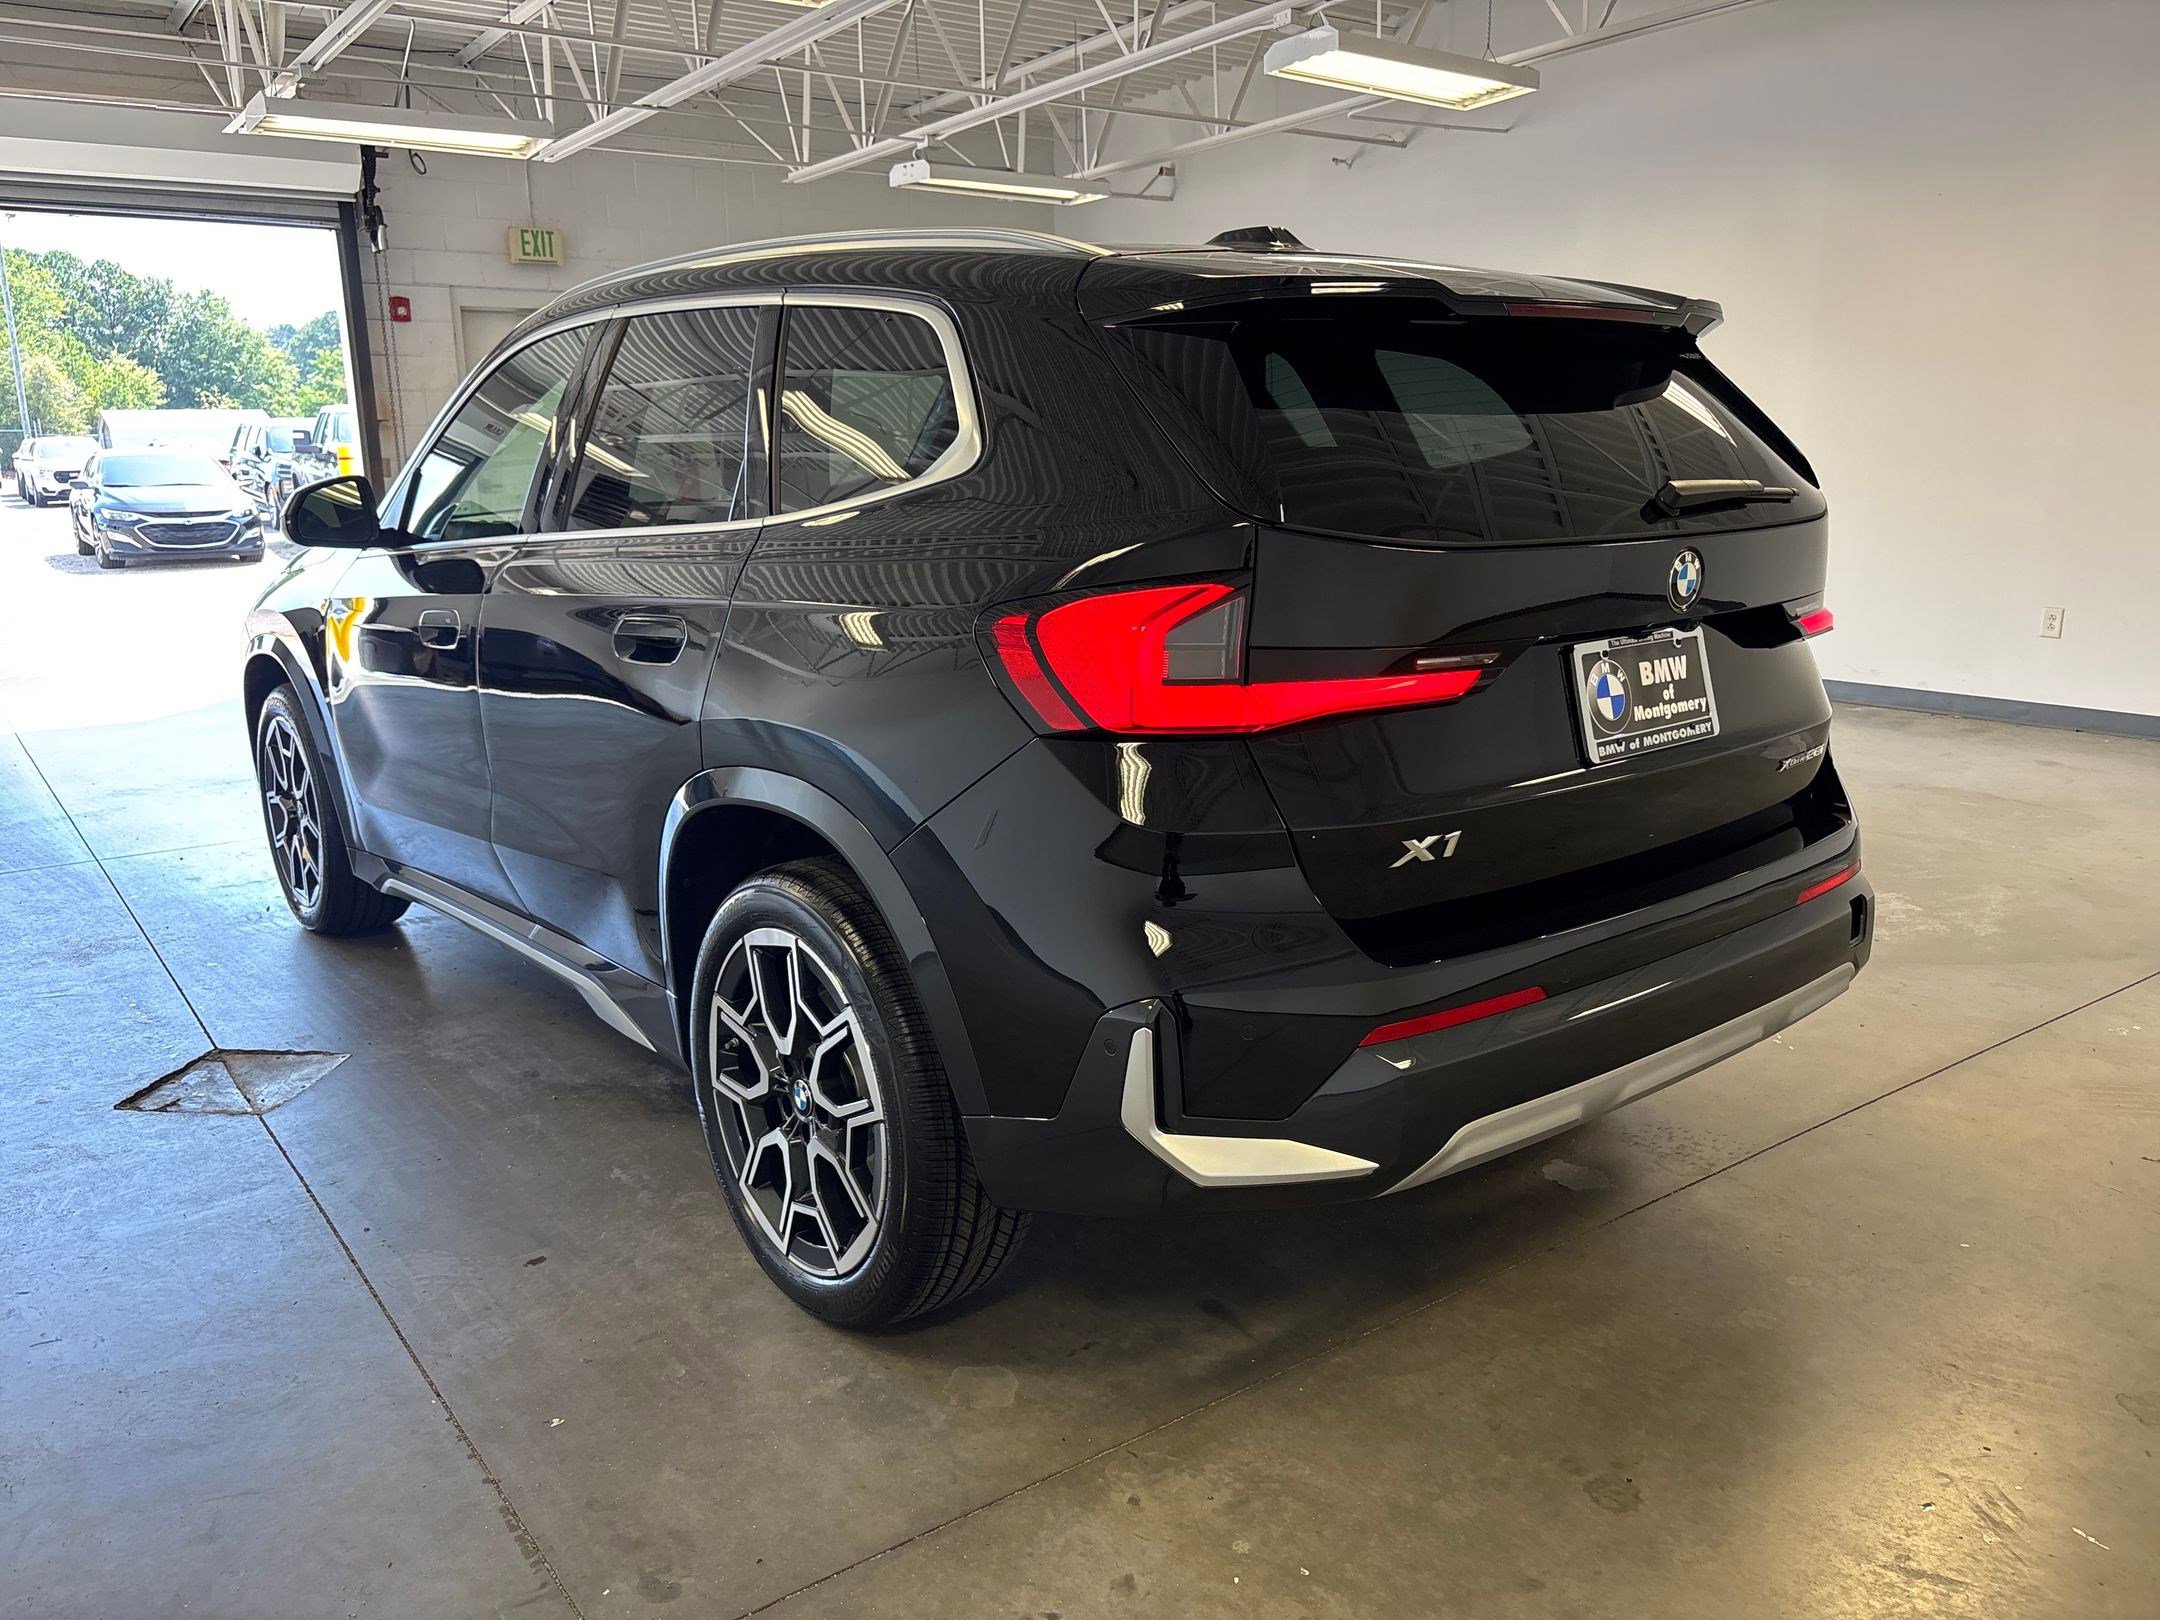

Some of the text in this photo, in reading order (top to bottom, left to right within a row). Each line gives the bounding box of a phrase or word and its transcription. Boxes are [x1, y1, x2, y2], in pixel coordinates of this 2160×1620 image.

[520, 229, 554, 258] EXIT
[1590, 663, 1626, 687] BMW
[1638, 654, 1687, 687] BMW
[1662, 683, 1675, 701] of
[1633, 696, 1707, 722] Montgomery
[1598, 721, 1712, 757] BMW of MONTGOMERY
[1387, 829, 1462, 869] X1
